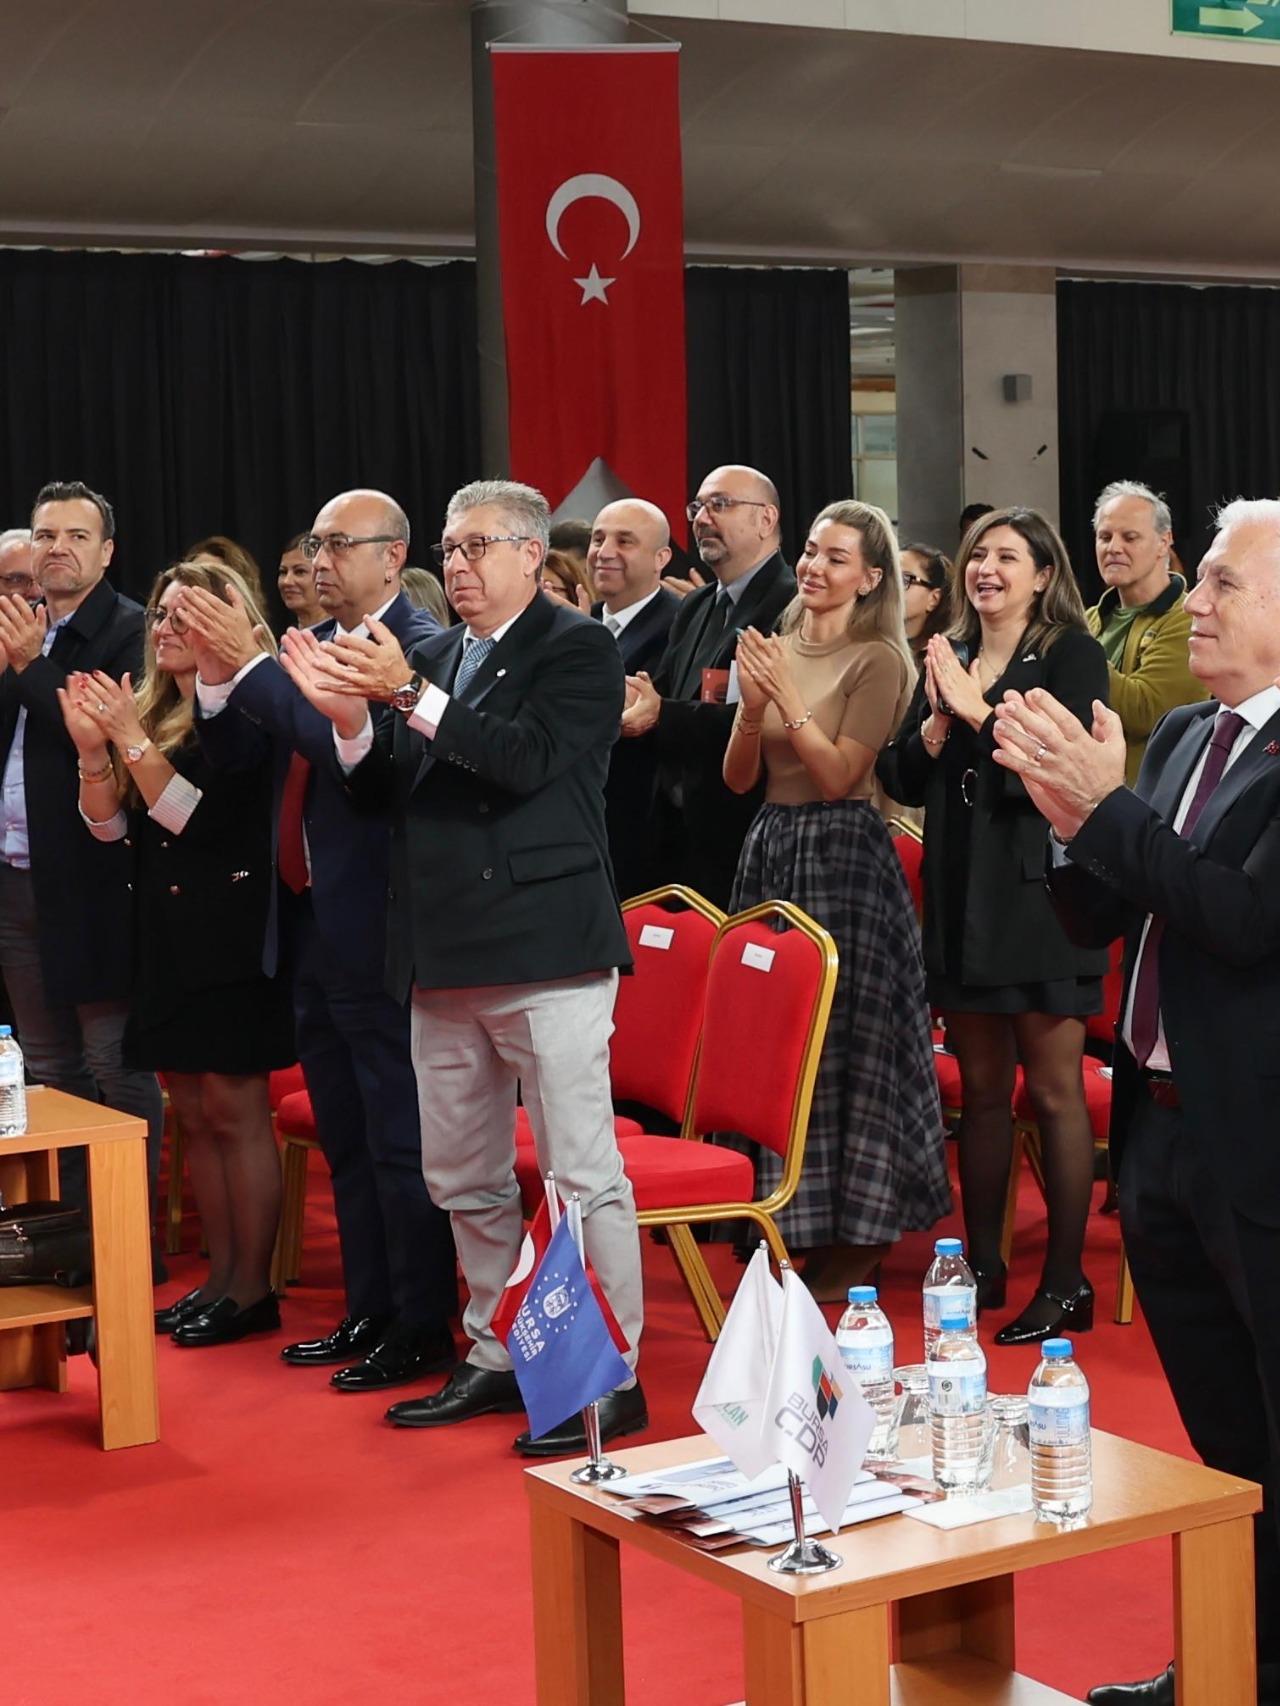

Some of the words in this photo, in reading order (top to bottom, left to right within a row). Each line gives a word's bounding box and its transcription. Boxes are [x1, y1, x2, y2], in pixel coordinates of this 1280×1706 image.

[520, 1294, 545, 1352] URSA
[722, 1402, 749, 1426] LAN
[787, 1391, 829, 1457] BURSA
